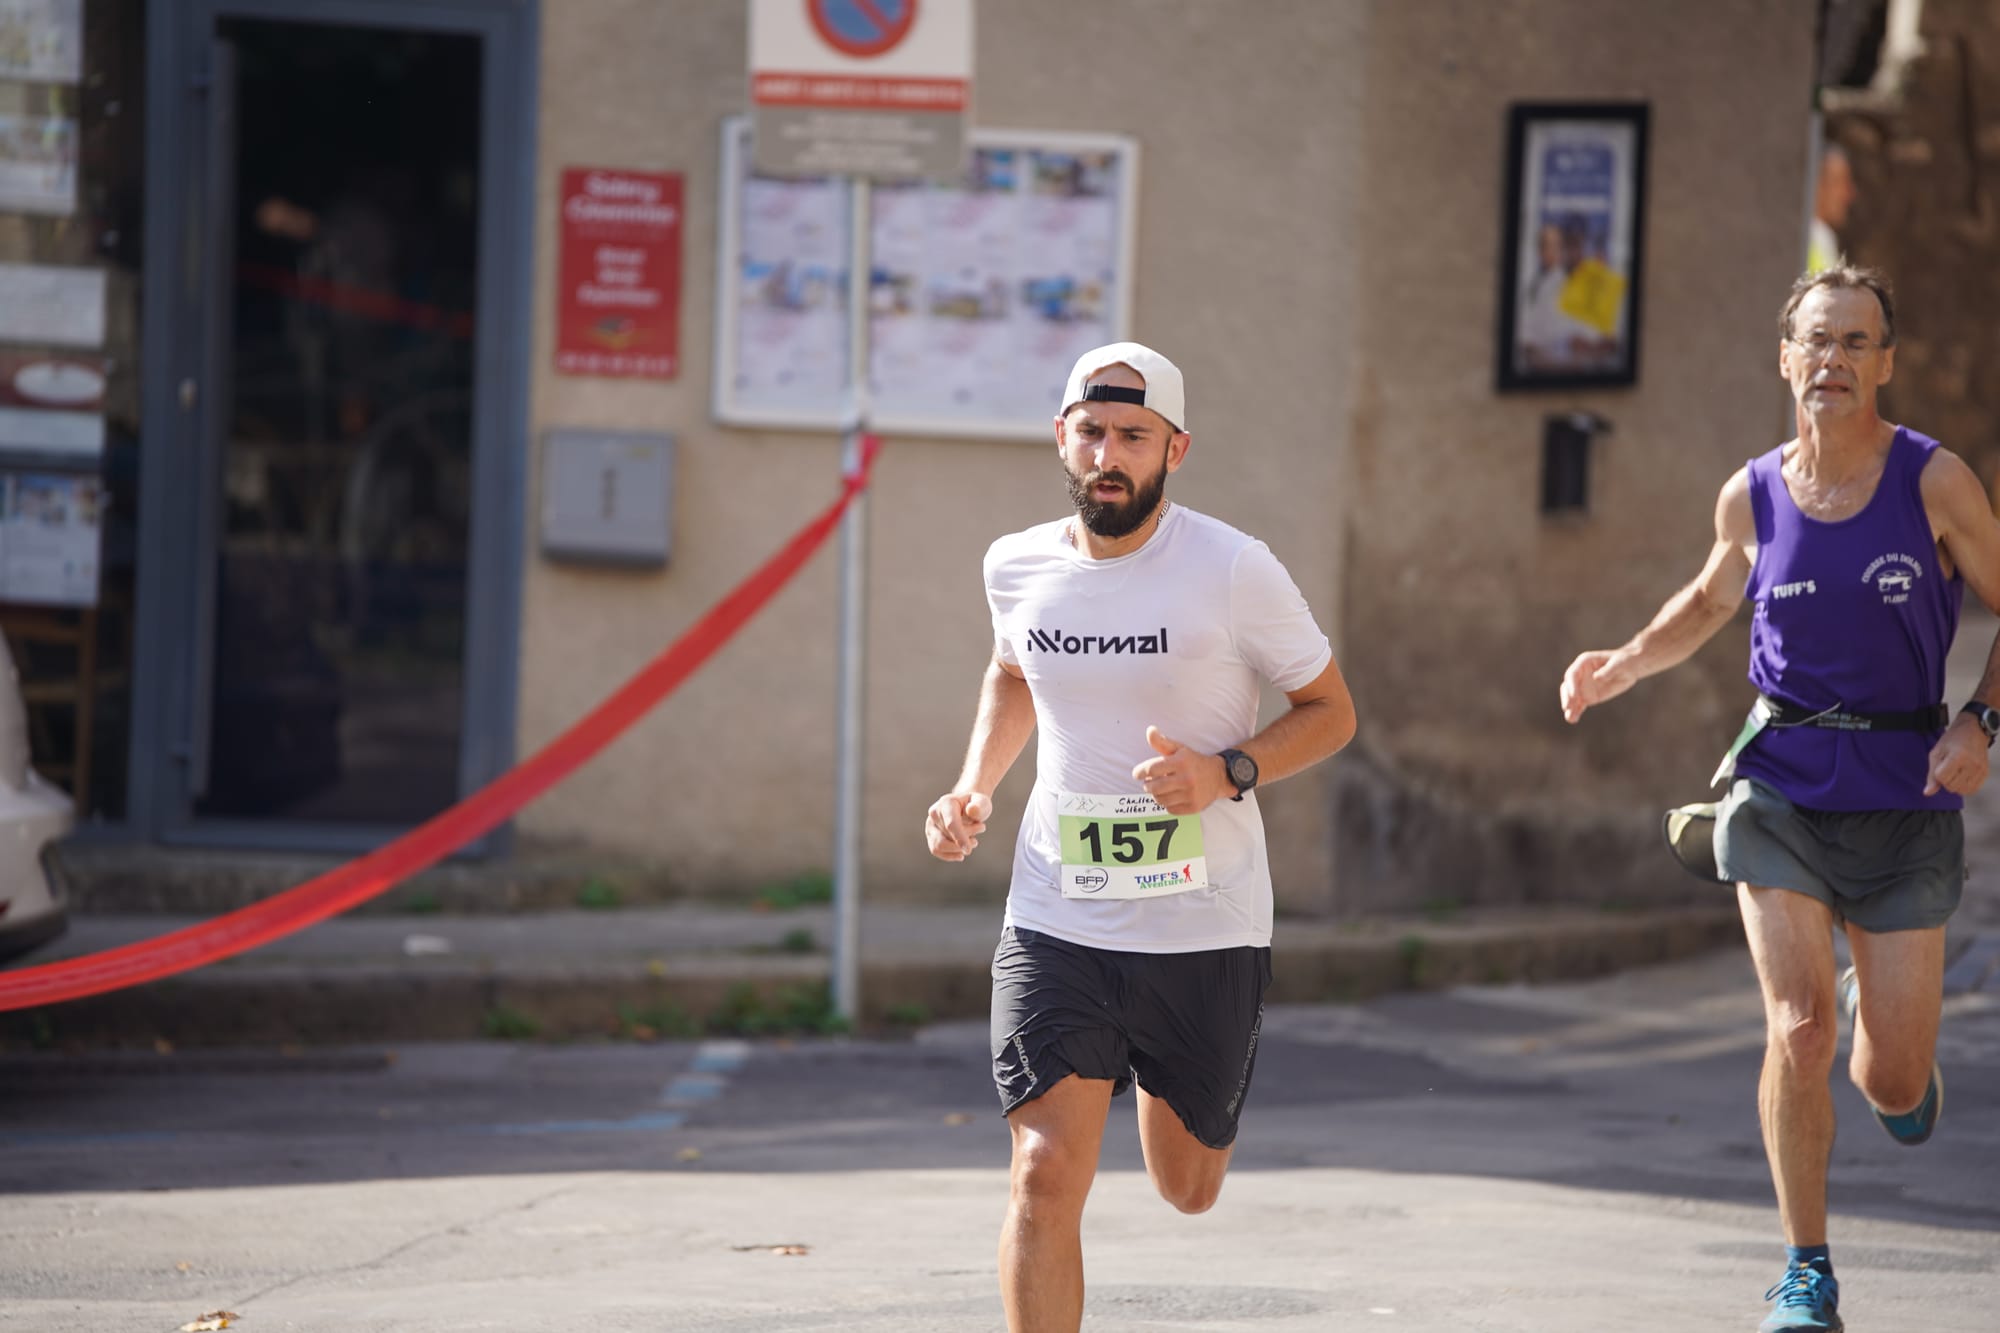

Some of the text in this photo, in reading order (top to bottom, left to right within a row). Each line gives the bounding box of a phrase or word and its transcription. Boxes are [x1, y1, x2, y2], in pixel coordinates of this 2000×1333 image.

[1771, 580, 1817, 599] TUFF'S
[1118, 796, 1158, 806] Challen
[1079, 818, 1180, 864] 157
[1075, 875, 1104, 885] BFP
[1134, 871, 1179, 885] TUFF'S
[1140, 878, 1184, 890] Aventure
